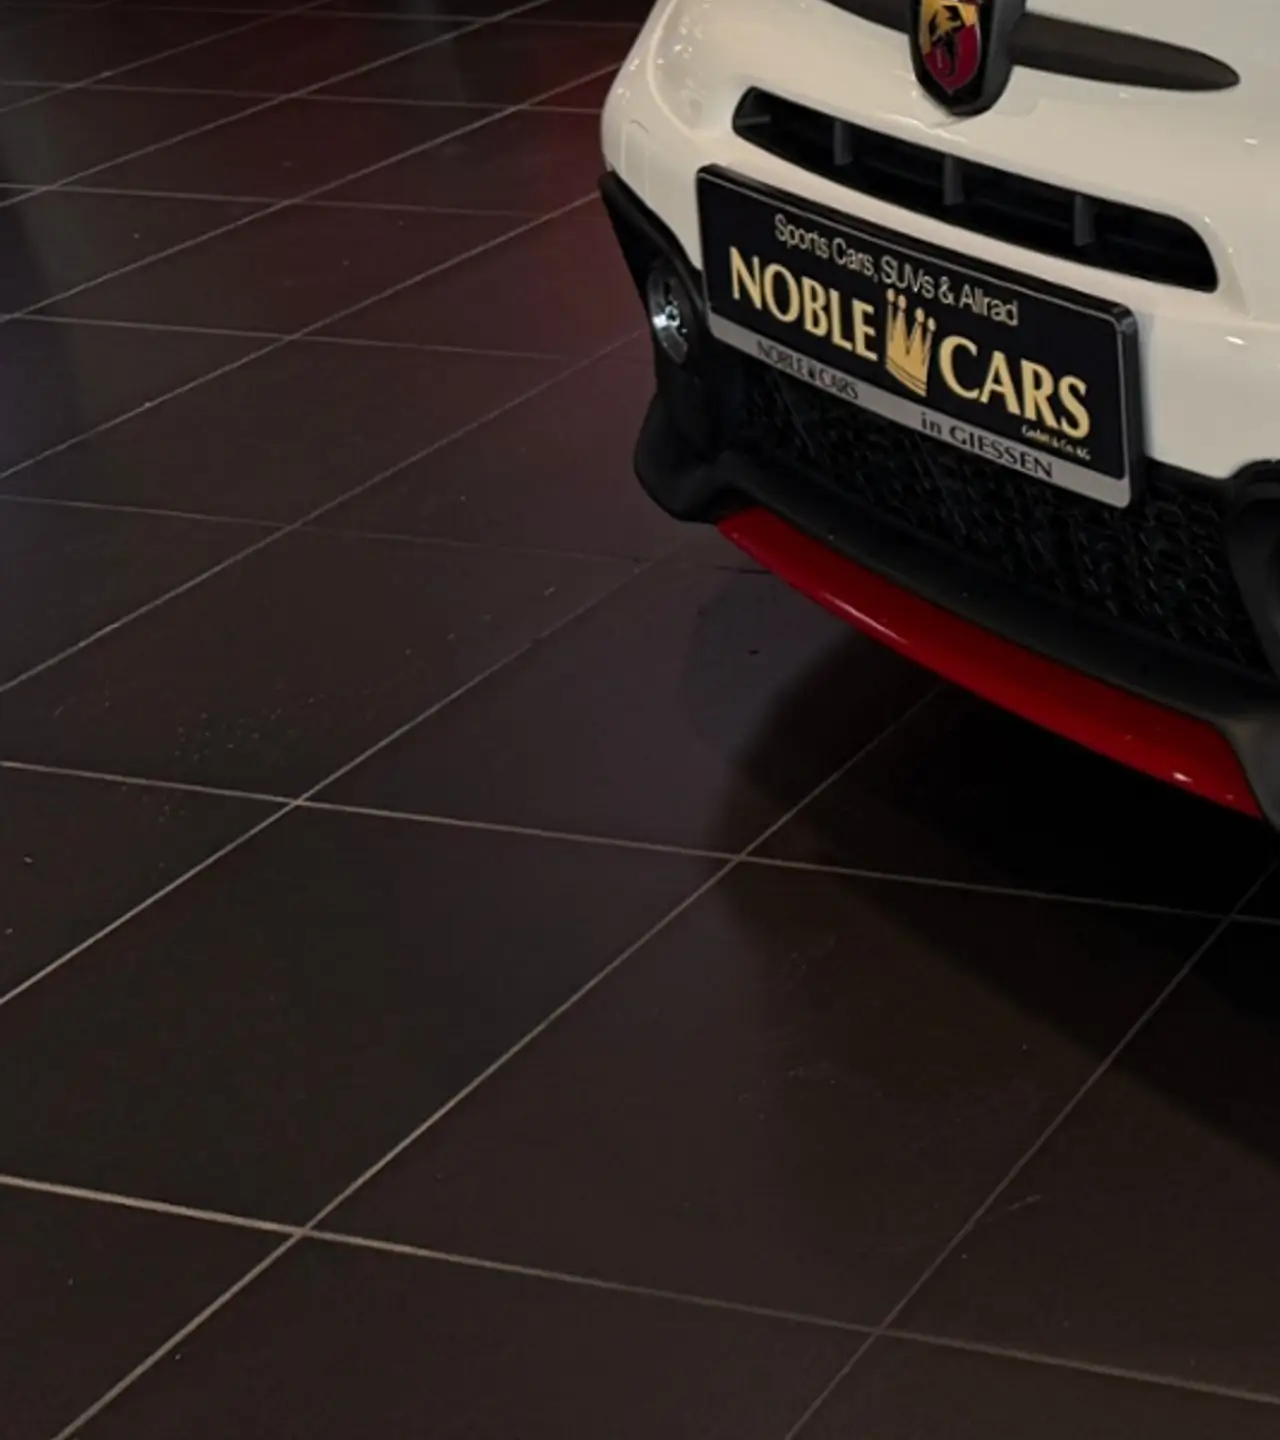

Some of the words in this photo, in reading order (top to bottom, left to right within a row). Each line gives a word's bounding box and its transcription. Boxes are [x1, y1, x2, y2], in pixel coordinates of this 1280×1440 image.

[774, 213, 829, 258] Sports
[832, 237, 879, 283] Cars,
[880, 254, 935, 299] SUVs
[938, 275, 956, 306] &
[959, 282, 1019, 326] Allrad
[729, 245, 878, 361] NOBLE
[938, 334, 1091, 439] CARS
[755, 339, 806, 379] NOBLE
[817, 367, 859, 401] CARS
[920, 412, 942, 436] in
[948, 423, 1053, 479] GIESSEN
